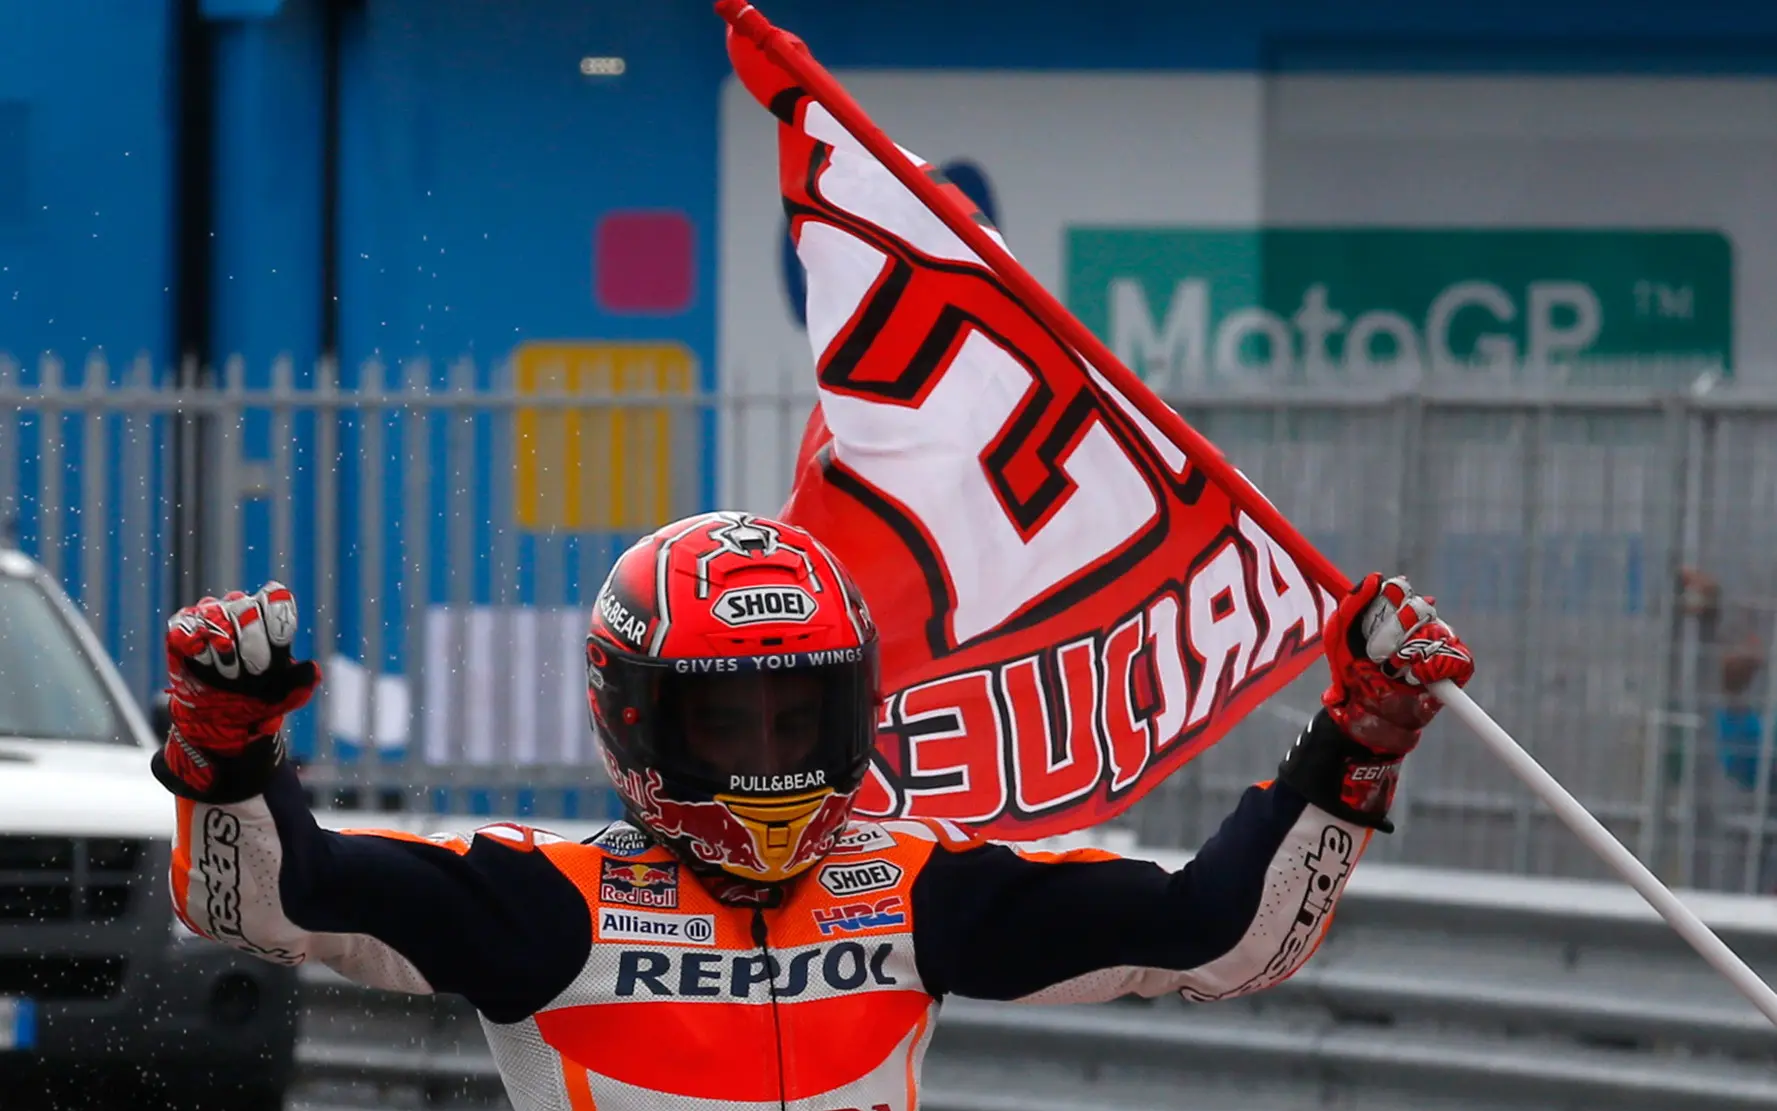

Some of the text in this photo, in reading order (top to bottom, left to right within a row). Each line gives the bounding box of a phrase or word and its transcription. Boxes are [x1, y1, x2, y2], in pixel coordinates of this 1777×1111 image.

[1108, 276, 1602, 392] MotoGP
[728, 595, 804, 618] SHOEI
[675, 648, 863, 673] GIVES YOU WINGS
[730, 770, 826, 792] PULL&BEAR
[828, 865, 892, 890] SHOEI
[601, 884, 677, 907] Red Bull
[602, 914, 678, 936] Allianz
[812, 896, 906, 936] HRC
[615, 942, 898, 998] REPSOL
